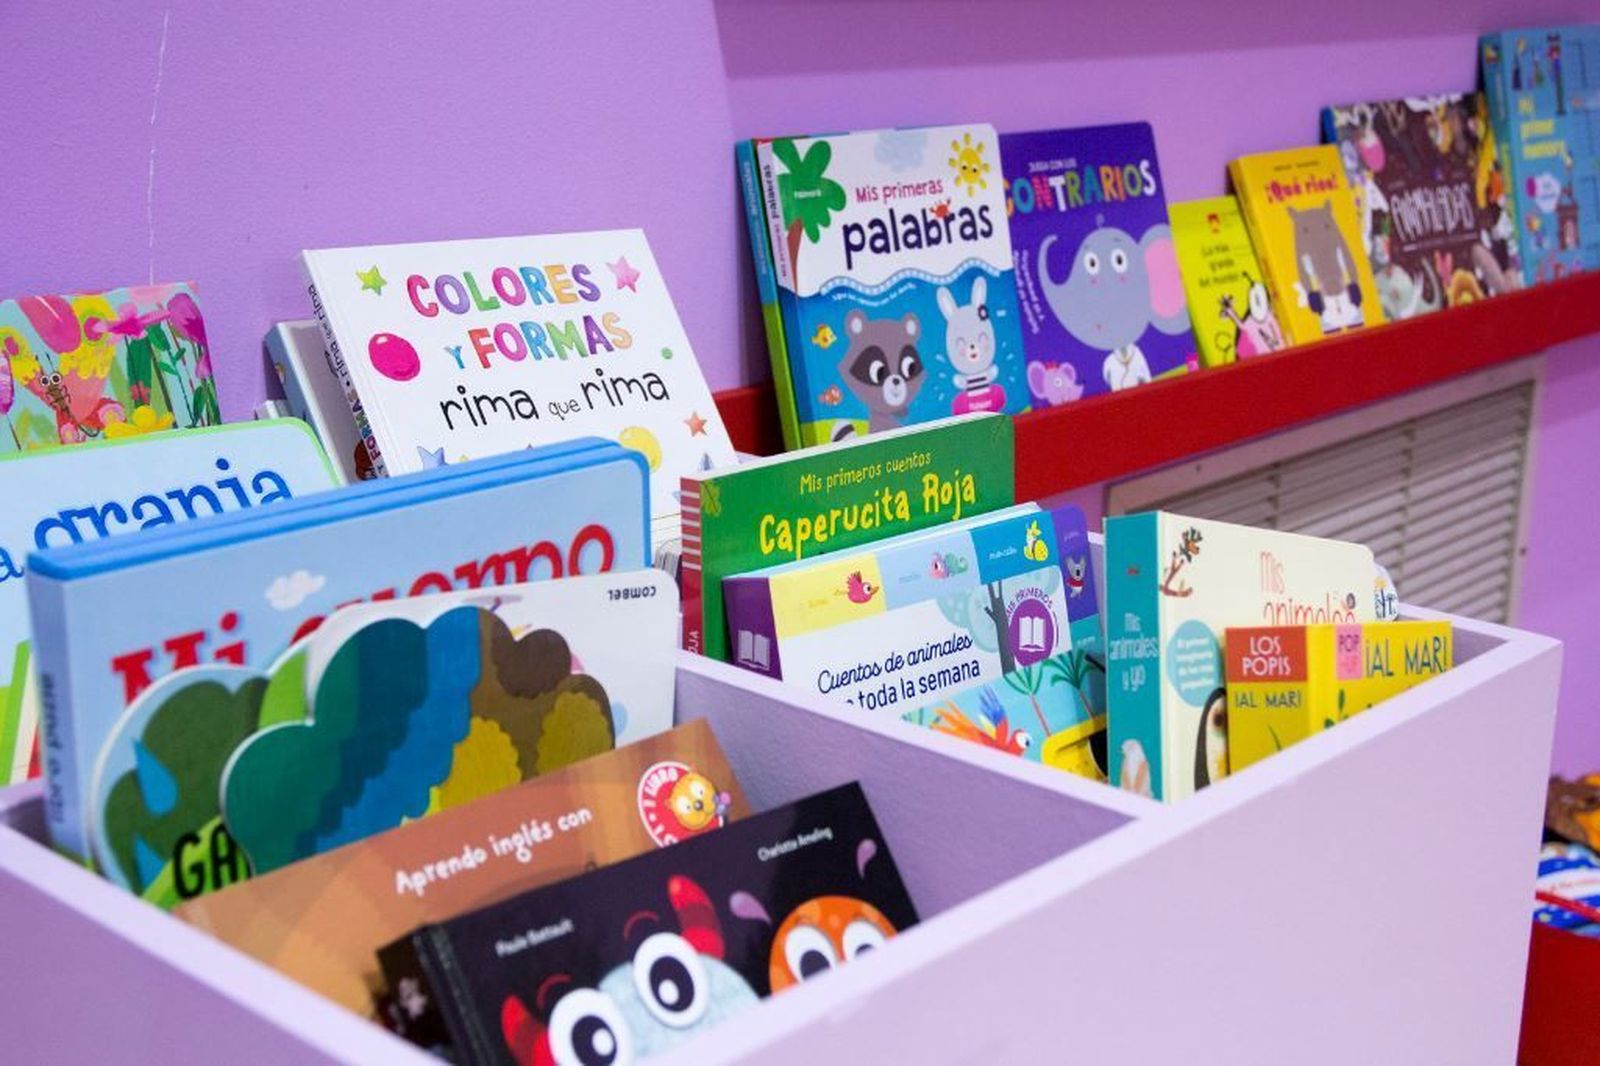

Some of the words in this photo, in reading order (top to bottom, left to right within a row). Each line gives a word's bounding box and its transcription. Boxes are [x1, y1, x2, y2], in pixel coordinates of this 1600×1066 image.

[855, 186, 879, 203] Mis
[882, 179, 944, 204] primeras
[842, 204, 993, 271] palabras
[307, 284, 324, 321] rima
[407, 263, 601, 317] COLORES
[329, 339, 349, 379] rima
[443, 345, 465, 369] Y
[468, 311, 633, 369] FORMAS
[439, 384, 539, 430] rima
[549, 399, 582, 421] que
[580, 368, 671, 410] rima
[347, 388, 383, 462] FORMAS
[800, 473, 823, 496] Mis
[826, 463, 882, 494] primeros
[885, 452, 931, 474] cuentos
[759, 486, 910, 562] Caperucita
[922, 470, 976, 522] Roja
[1260, 551, 1285, 594] Mis
[817, 662, 882, 694] Cuentos
[884, 652, 905, 673] de
[906, 633, 973, 666] animales
[1109, 633, 1159, 661] animales
[1250, 636, 1281, 656] LOS
[1339, 634, 1359, 652] POP
[1365, 638, 1395, 679] ¡AL
[1405, 636, 1448, 675] MAR!
[858, 684, 898, 711] toda
[900, 677, 915, 700] la
[919, 659, 981, 694] semana
[1242, 656, 1292, 677] POPIS
[644, 766, 679, 798] LIBRO
[173, 823, 253, 900] GA
[395, 845, 487, 897] Aprendo
[489, 819, 554, 864] inglés
[558, 808, 593, 831] con
